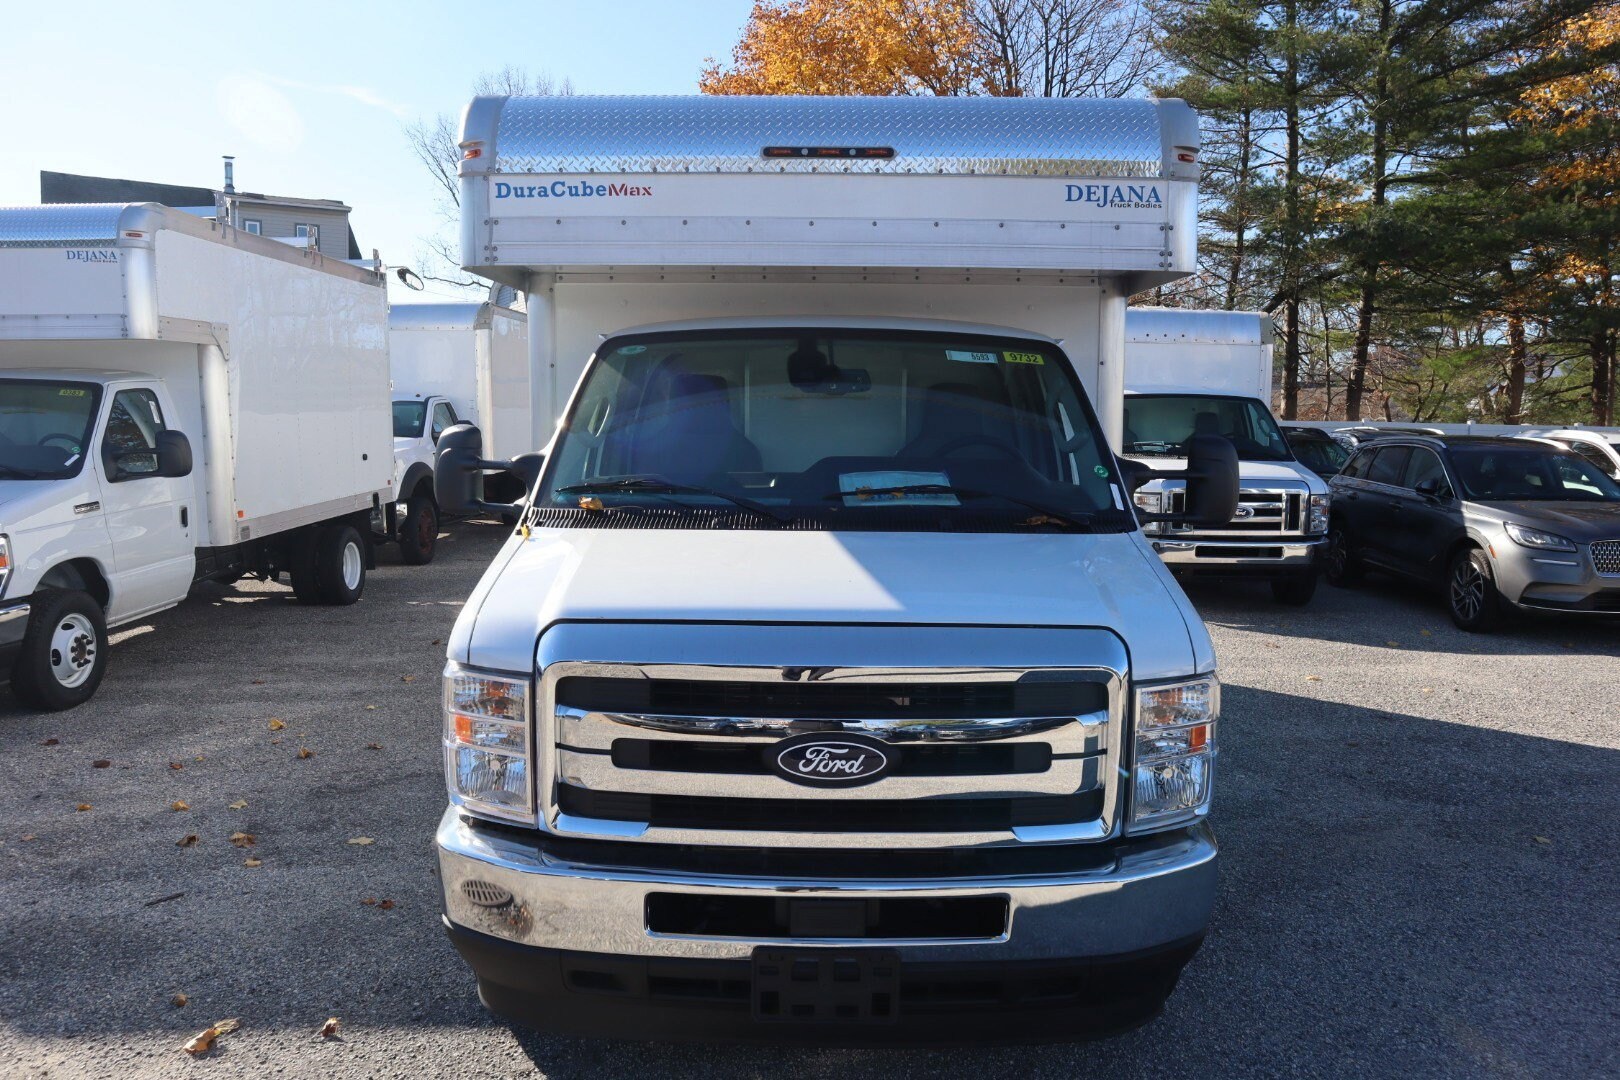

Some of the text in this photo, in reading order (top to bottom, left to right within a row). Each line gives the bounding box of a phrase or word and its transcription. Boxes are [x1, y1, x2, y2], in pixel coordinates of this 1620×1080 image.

[495, 181, 652, 198] DuraCubeMax
[1065, 184, 1162, 208] DEJANA
[66, 250, 117, 262] DEJANA
[1009, 352, 1038, 363] 9732
[798, 746, 866, 774] Ford
